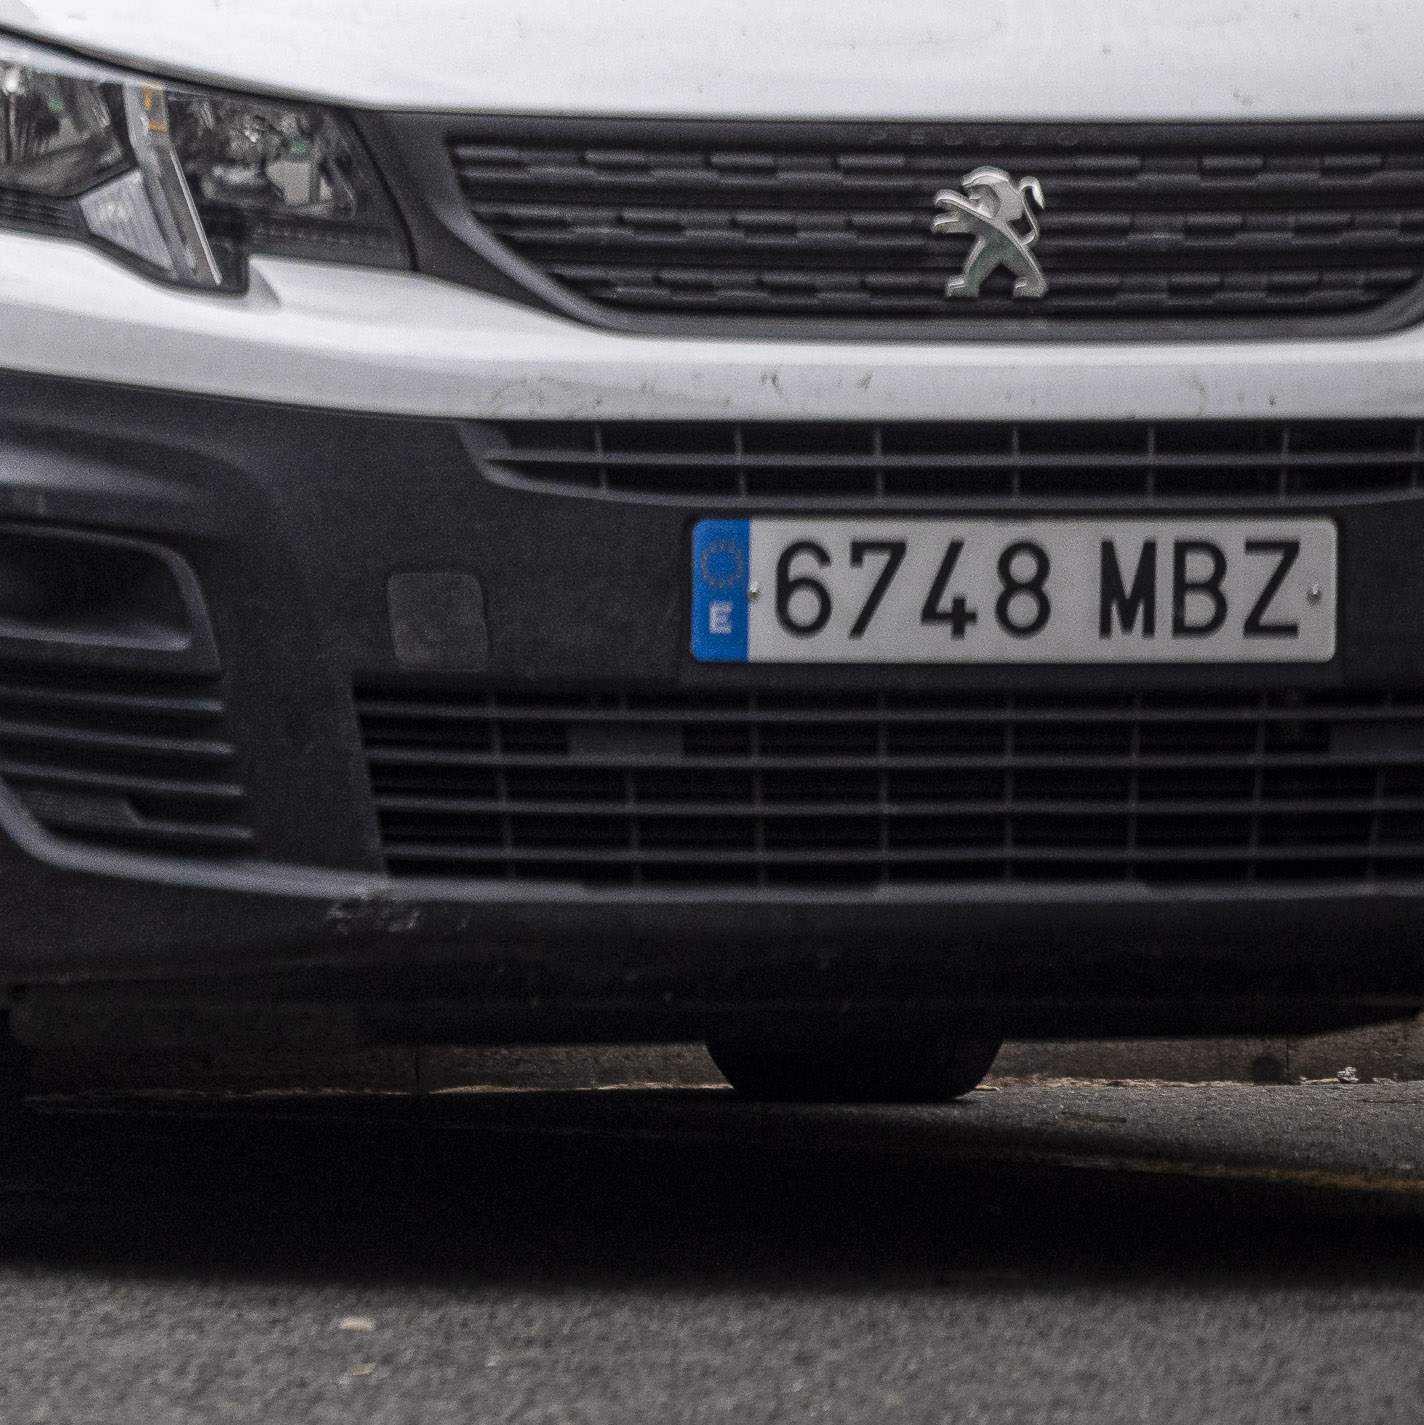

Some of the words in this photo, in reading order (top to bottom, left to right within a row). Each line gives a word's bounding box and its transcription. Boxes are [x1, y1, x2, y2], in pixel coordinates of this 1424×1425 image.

[709, 601, 732, 634] E
[774, 539, 1051, 640] 6748
[1099, 539, 1301, 640] MBZ
